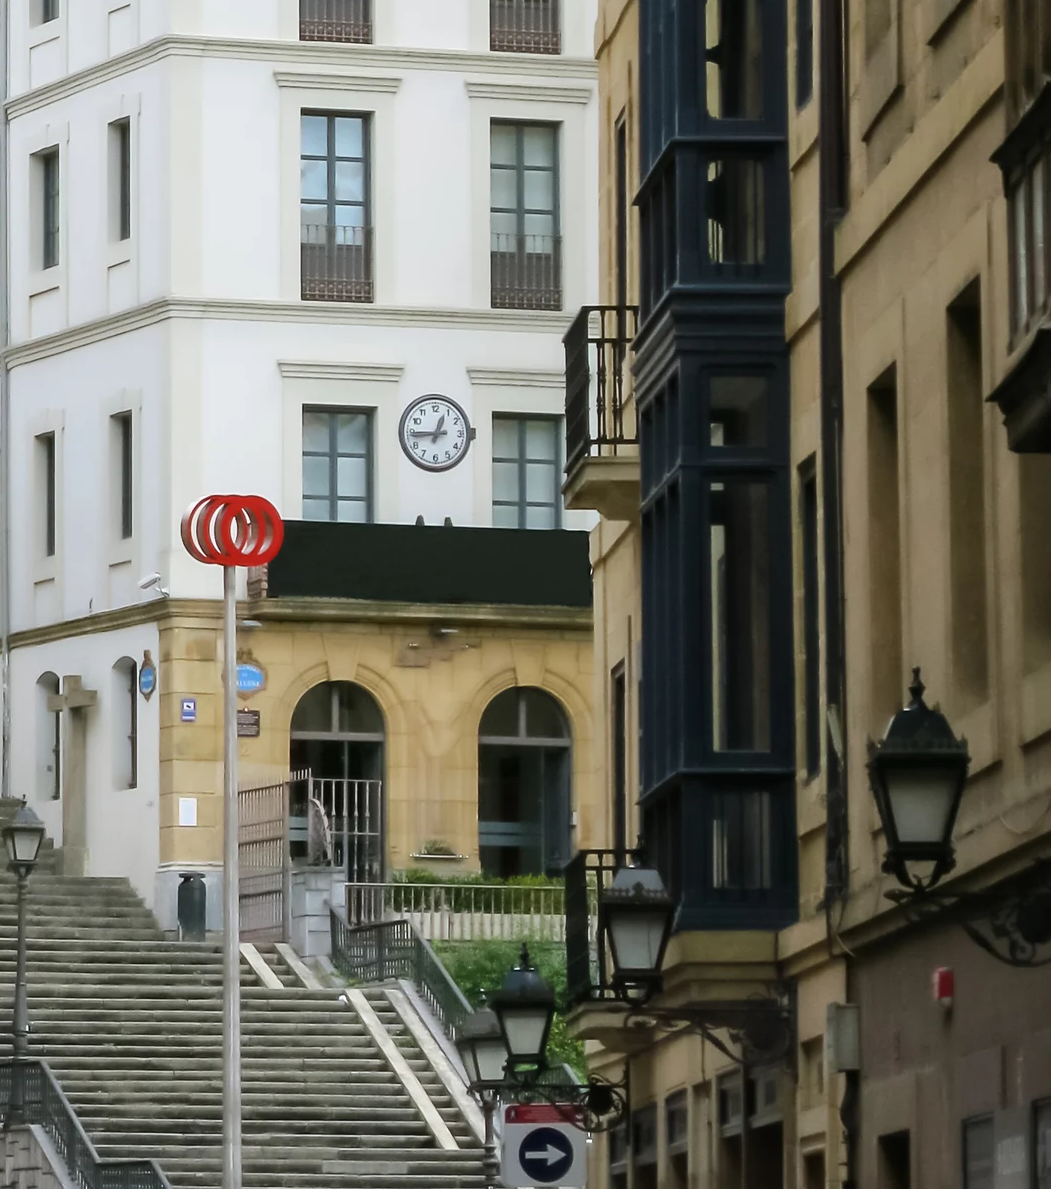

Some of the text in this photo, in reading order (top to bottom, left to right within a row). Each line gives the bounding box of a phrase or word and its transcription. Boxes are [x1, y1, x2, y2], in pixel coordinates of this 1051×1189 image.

[431, 405, 439, 413] 12
[457, 430, 462, 438] 3
[433, 454, 439, 462] 6
